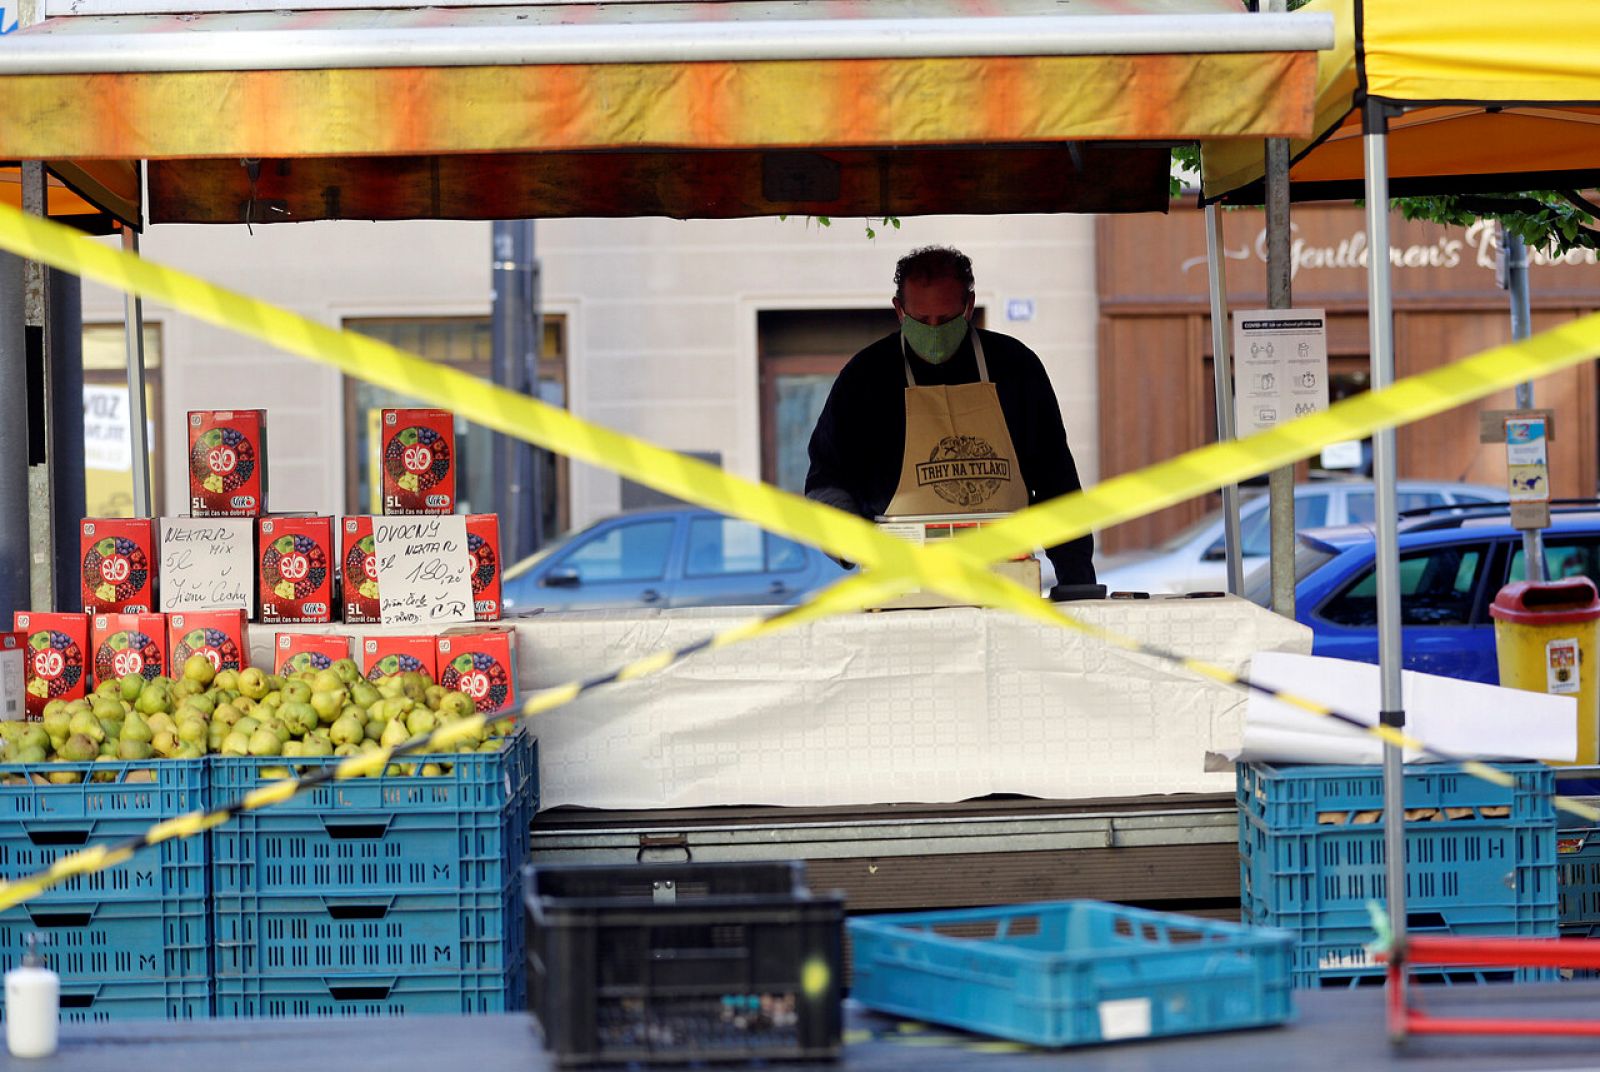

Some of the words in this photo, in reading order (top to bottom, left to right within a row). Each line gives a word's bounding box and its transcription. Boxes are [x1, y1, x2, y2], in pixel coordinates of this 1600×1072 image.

[921, 464, 950, 481] TRHY
[952, 462, 968, 476] NA
[192, 496, 207, 509] 5L
[387, 495, 402, 507] 5L
[263, 603, 278, 615] 5L
[347, 603, 363, 614] 5L
[136, 869, 153, 888] M
[433, 863, 450, 880] M
[434, 944, 451, 962] M
[139, 954, 156, 971] M
